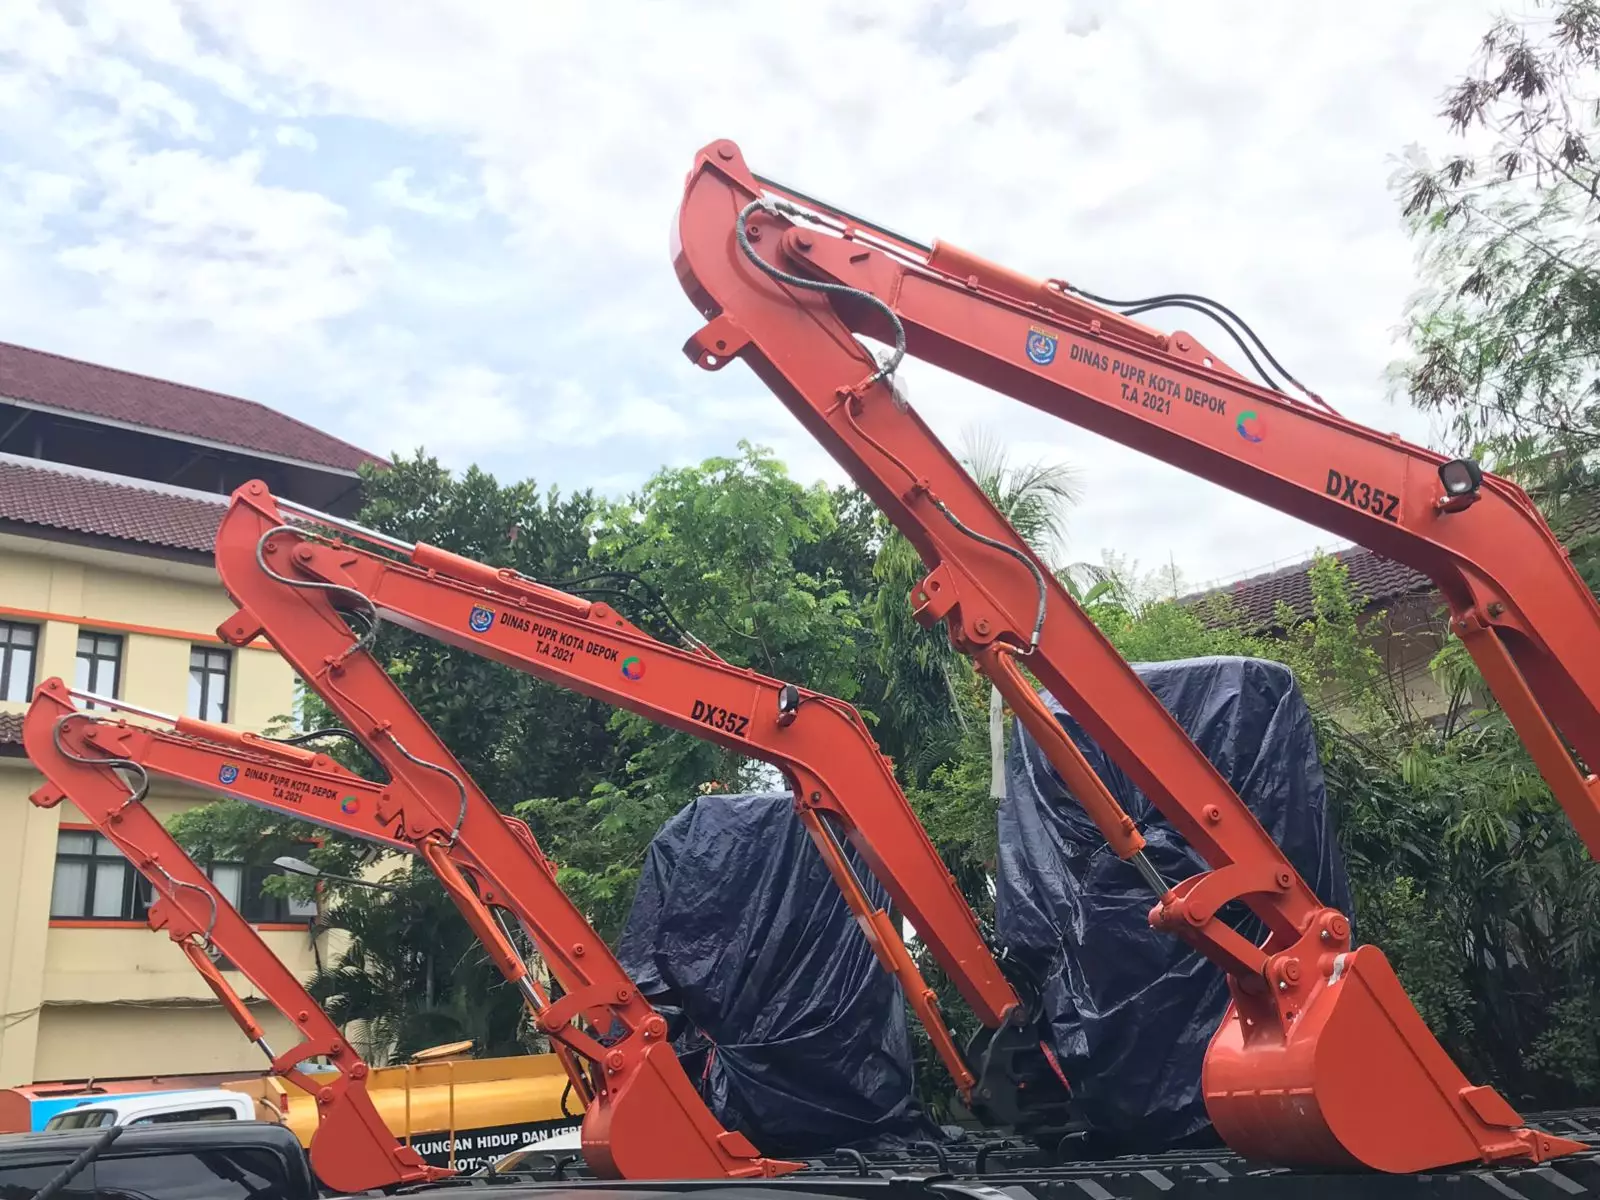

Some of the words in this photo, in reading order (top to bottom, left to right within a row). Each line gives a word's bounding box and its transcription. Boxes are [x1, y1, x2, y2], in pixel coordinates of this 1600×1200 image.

[1070, 343, 1109, 371] DINAS
[1112, 359, 1145, 386] PUPR
[1149, 374, 1181, 399] KOTA
[1185, 388, 1226, 415] DEPOK
[1120, 383, 1139, 404] T.A
[1142, 392, 1171, 415] 2021
[1326, 468, 1400, 522] DX35Z
[501, 612, 530, 632] DINAS
[532, 623, 558, 642] PUPR
[559, 632, 584, 651] KOTA
[586, 641, 618, 662] DEPOK
[535, 640, 550, 655] T.A
[552, 647, 575, 664] 2021
[691, 699, 750, 737] DX35Z
[244, 767, 268, 782] DINAS
[269, 774, 290, 788] PUPR
[291, 780, 310, 794] KOTA
[312, 786, 338, 800] DEPOK
[272, 787, 284, 799] T.A
[285, 791, 303, 804] 2021
[477, 1133, 518, 1148] HIDUP
[522, 1129, 548, 1144] DAN
